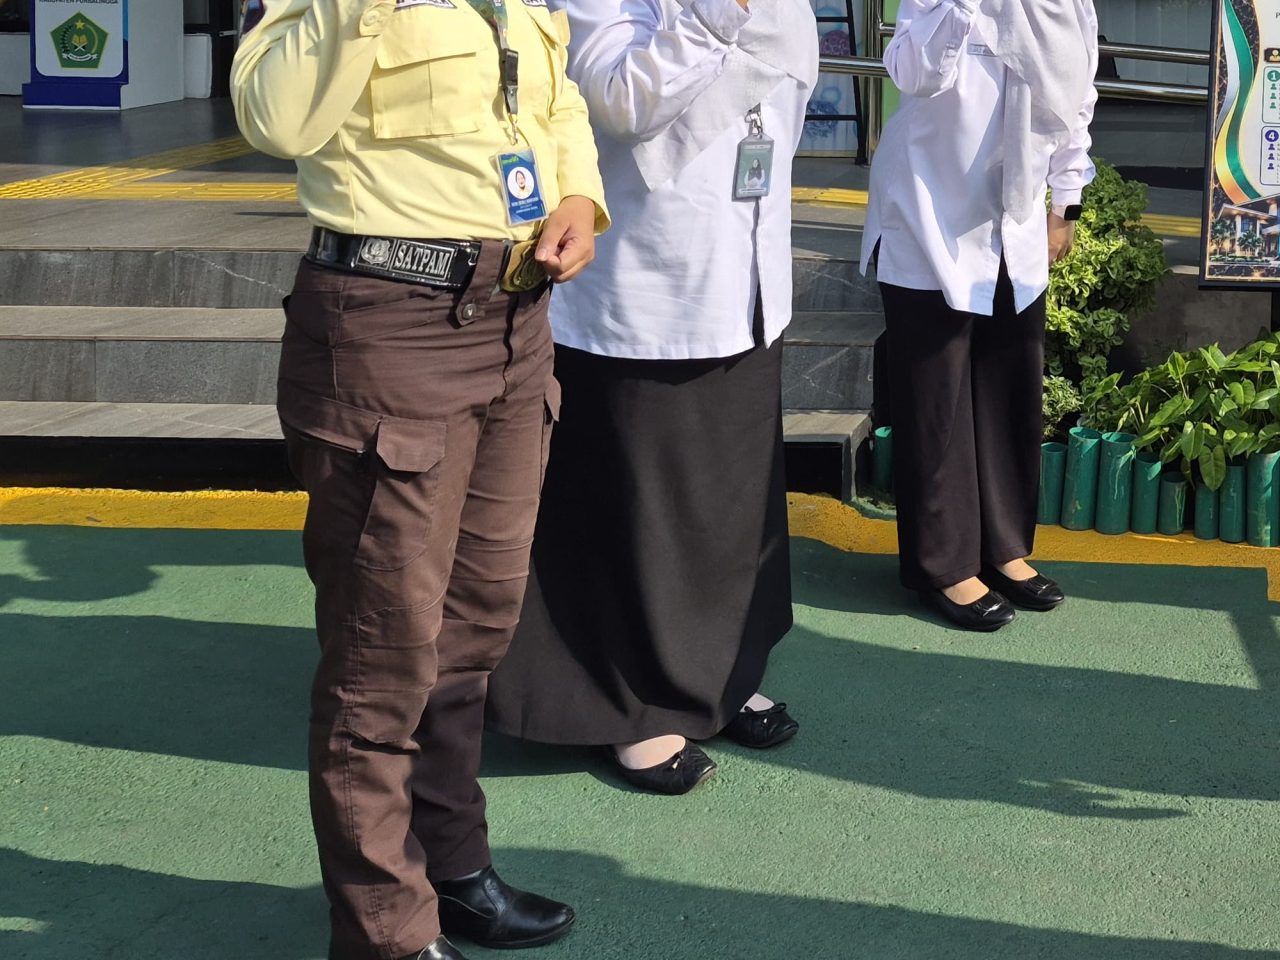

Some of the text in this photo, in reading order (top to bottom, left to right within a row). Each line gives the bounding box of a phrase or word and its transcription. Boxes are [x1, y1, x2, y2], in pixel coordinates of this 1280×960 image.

[1271, 72, 1277, 80] 1
[1269, 132, 1276, 140] 4
[395, 243, 451, 276] SATPAM
